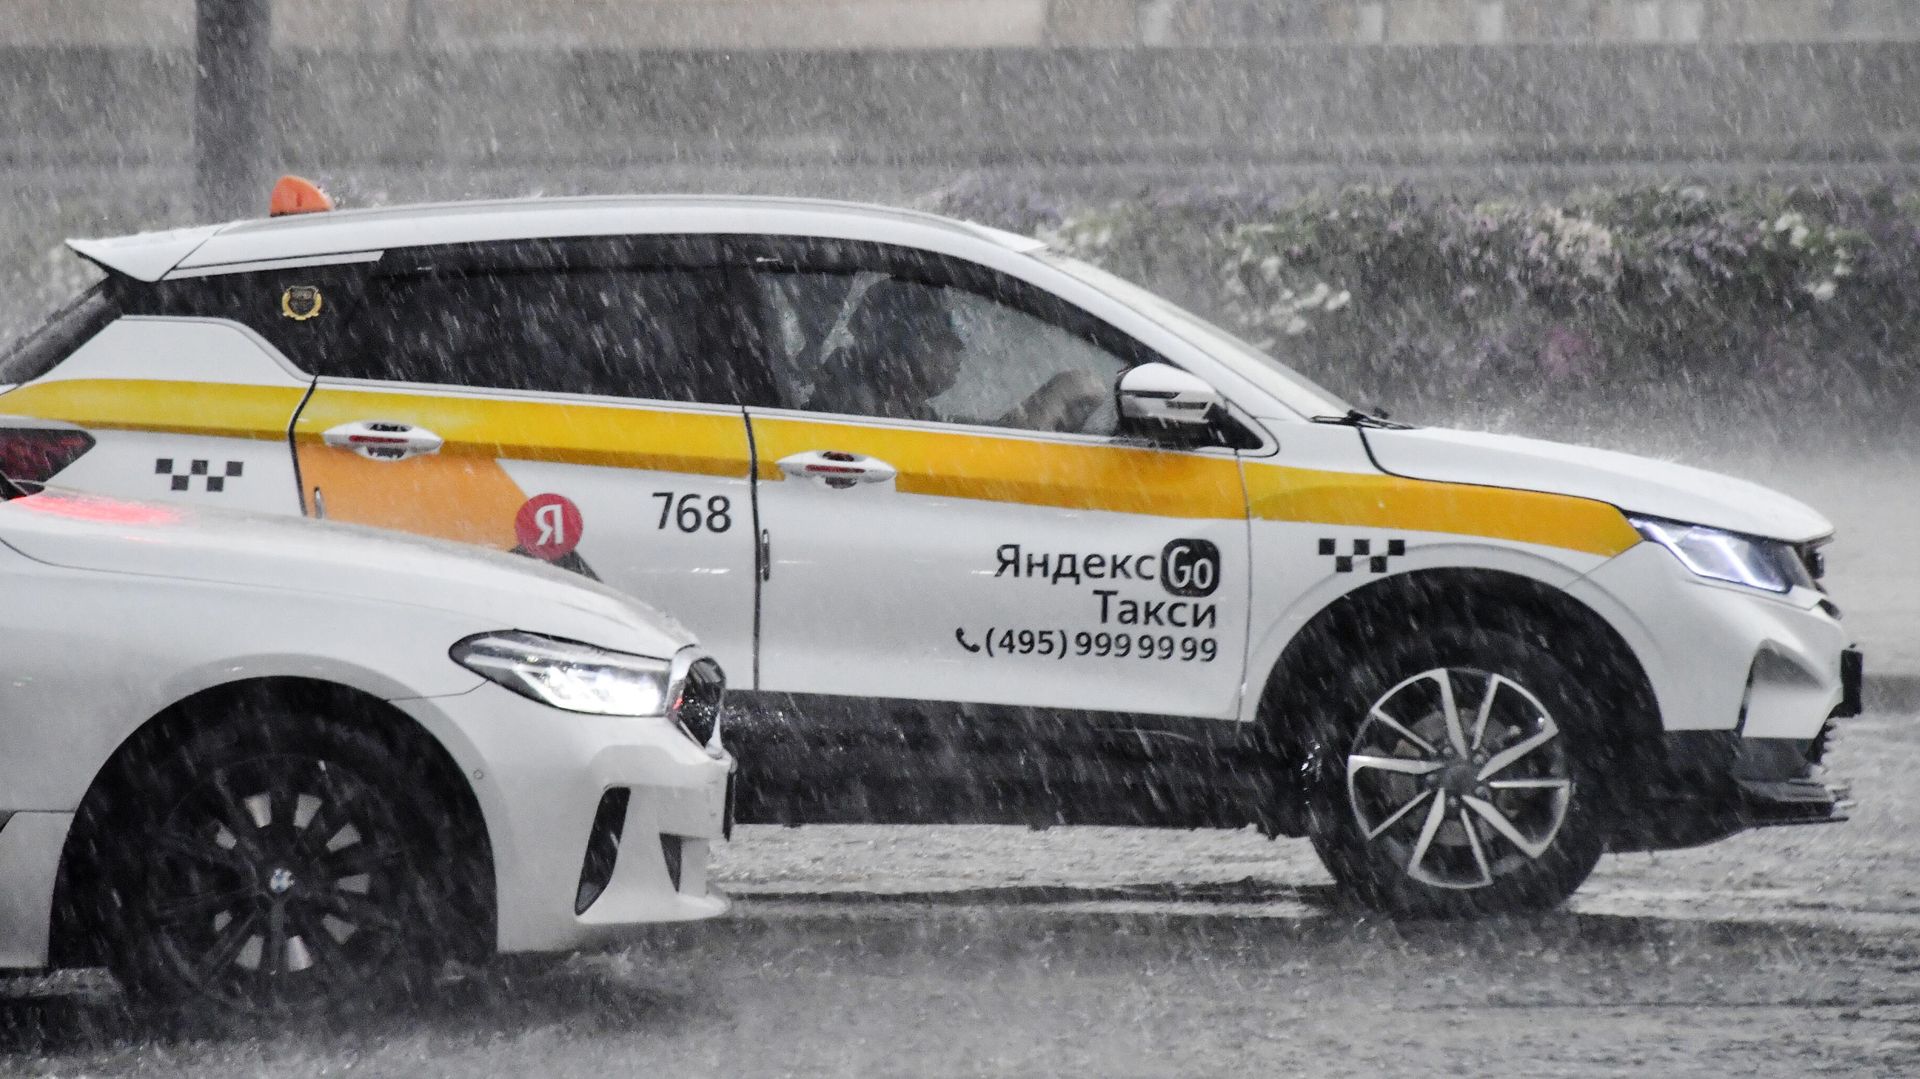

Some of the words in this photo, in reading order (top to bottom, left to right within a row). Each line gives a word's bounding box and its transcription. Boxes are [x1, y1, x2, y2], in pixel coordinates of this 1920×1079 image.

[534, 503, 565, 546] Я
[652, 491, 732, 534] 768
[994, 543, 1156, 586] Яндекс
[1167, 545, 1214, 590] Go
[1092, 589, 1217, 629] Такси
[985, 627, 1068, 660] (495)
